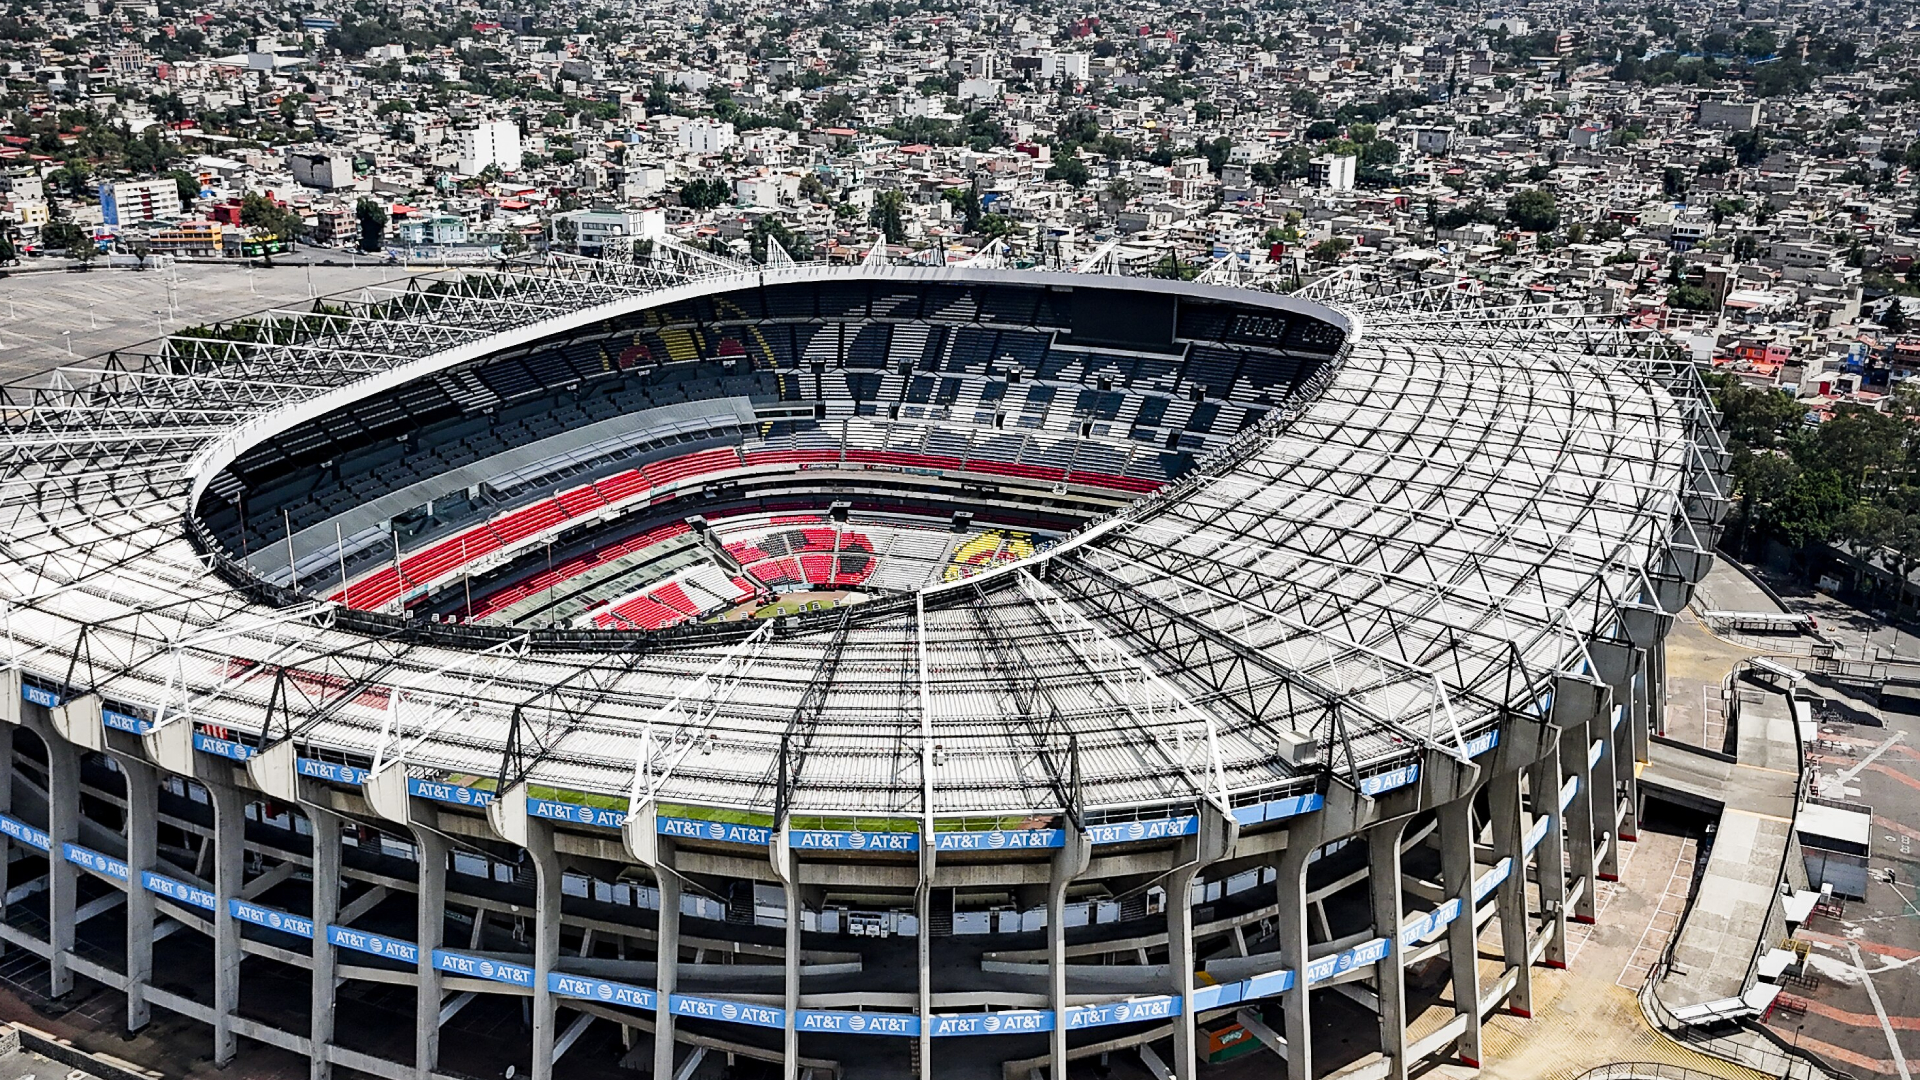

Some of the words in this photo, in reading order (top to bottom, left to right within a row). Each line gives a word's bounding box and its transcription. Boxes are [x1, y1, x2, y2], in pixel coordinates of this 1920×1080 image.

[29, 688, 51, 705] AT&T
[109, 714, 135, 731] AT&T
[202, 738, 231, 755] AT&T
[1470, 732, 1492, 756] AT&T
[305, 762, 336, 778] AT&T
[1383, 768, 1414, 788] AT&T
[418, 783, 451, 799] AT&T
[474, 792, 495, 806] AT
[537, 802, 573, 819] AT&T
[597, 811, 626, 827] AT&
[1, 819, 21, 836] AT&T
[33, 833, 50, 848] AT&
[664, 820, 704, 836] AT&T
[729, 827, 768, 844] AT&T
[1148, 819, 1188, 836] AT&T
[801, 833, 843, 848] AT&T
[869, 834, 912, 849] AT&T
[941, 834, 982, 849] AT&T
[1008, 831, 1050, 847] AT&T
[70, 849, 94, 866] AT&T
[149, 877, 174, 894] AT&T
[190, 890, 215, 908] AT&T
[237, 905, 265, 923] AT&T
[283, 918, 313, 935] AT&T
[1435, 905, 1456, 924] AT&T
[336, 931, 366, 948] AT&T
[385, 942, 416, 959] AT&T
[442, 955, 475, 973] AT&T
[497, 966, 530, 983] AT&T
[1308, 962, 1337, 980] AT&T
[1352, 943, 1383, 964] AT&T
[558, 978, 593, 995] AT&T
[616, 989, 652, 1005] AT&T
[679, 1000, 717, 1016] AT&T
[740, 1008, 780, 1024] AT&T
[804, 1014, 844, 1029] AT&T
[869, 1017, 909, 1032] AT&T
[1071, 1009, 1111, 1025] AT&T
[1133, 1000, 1171, 1017] AT&T
[938, 1019, 980, 1033] AT&T
[1003, 1015, 1044, 1030] AT&T
